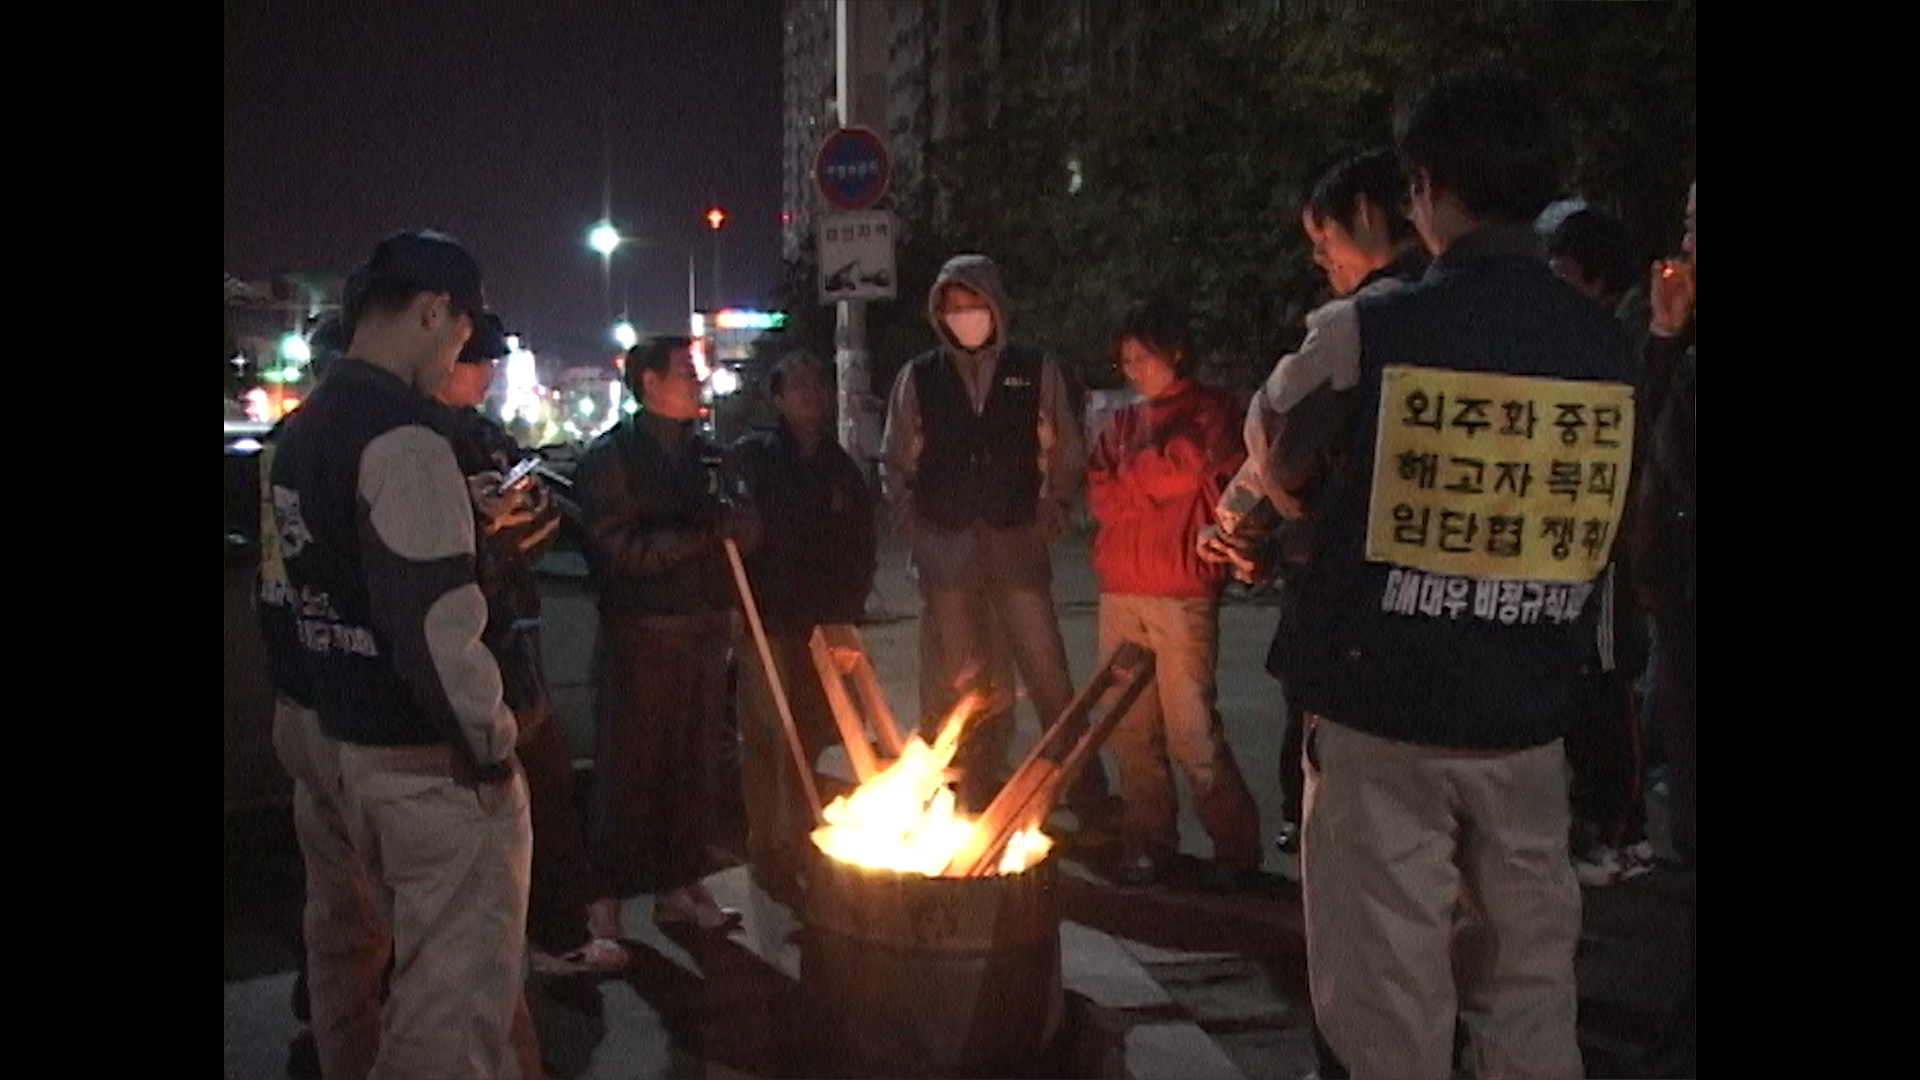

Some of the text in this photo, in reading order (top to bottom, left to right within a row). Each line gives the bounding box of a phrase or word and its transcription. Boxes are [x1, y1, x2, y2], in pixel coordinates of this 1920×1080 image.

[1402, 390, 1622, 449] 외주화 중단
[1396, 449, 1535, 498] 해고자
[1391, 502, 1610, 562] 임단협 쟁취
